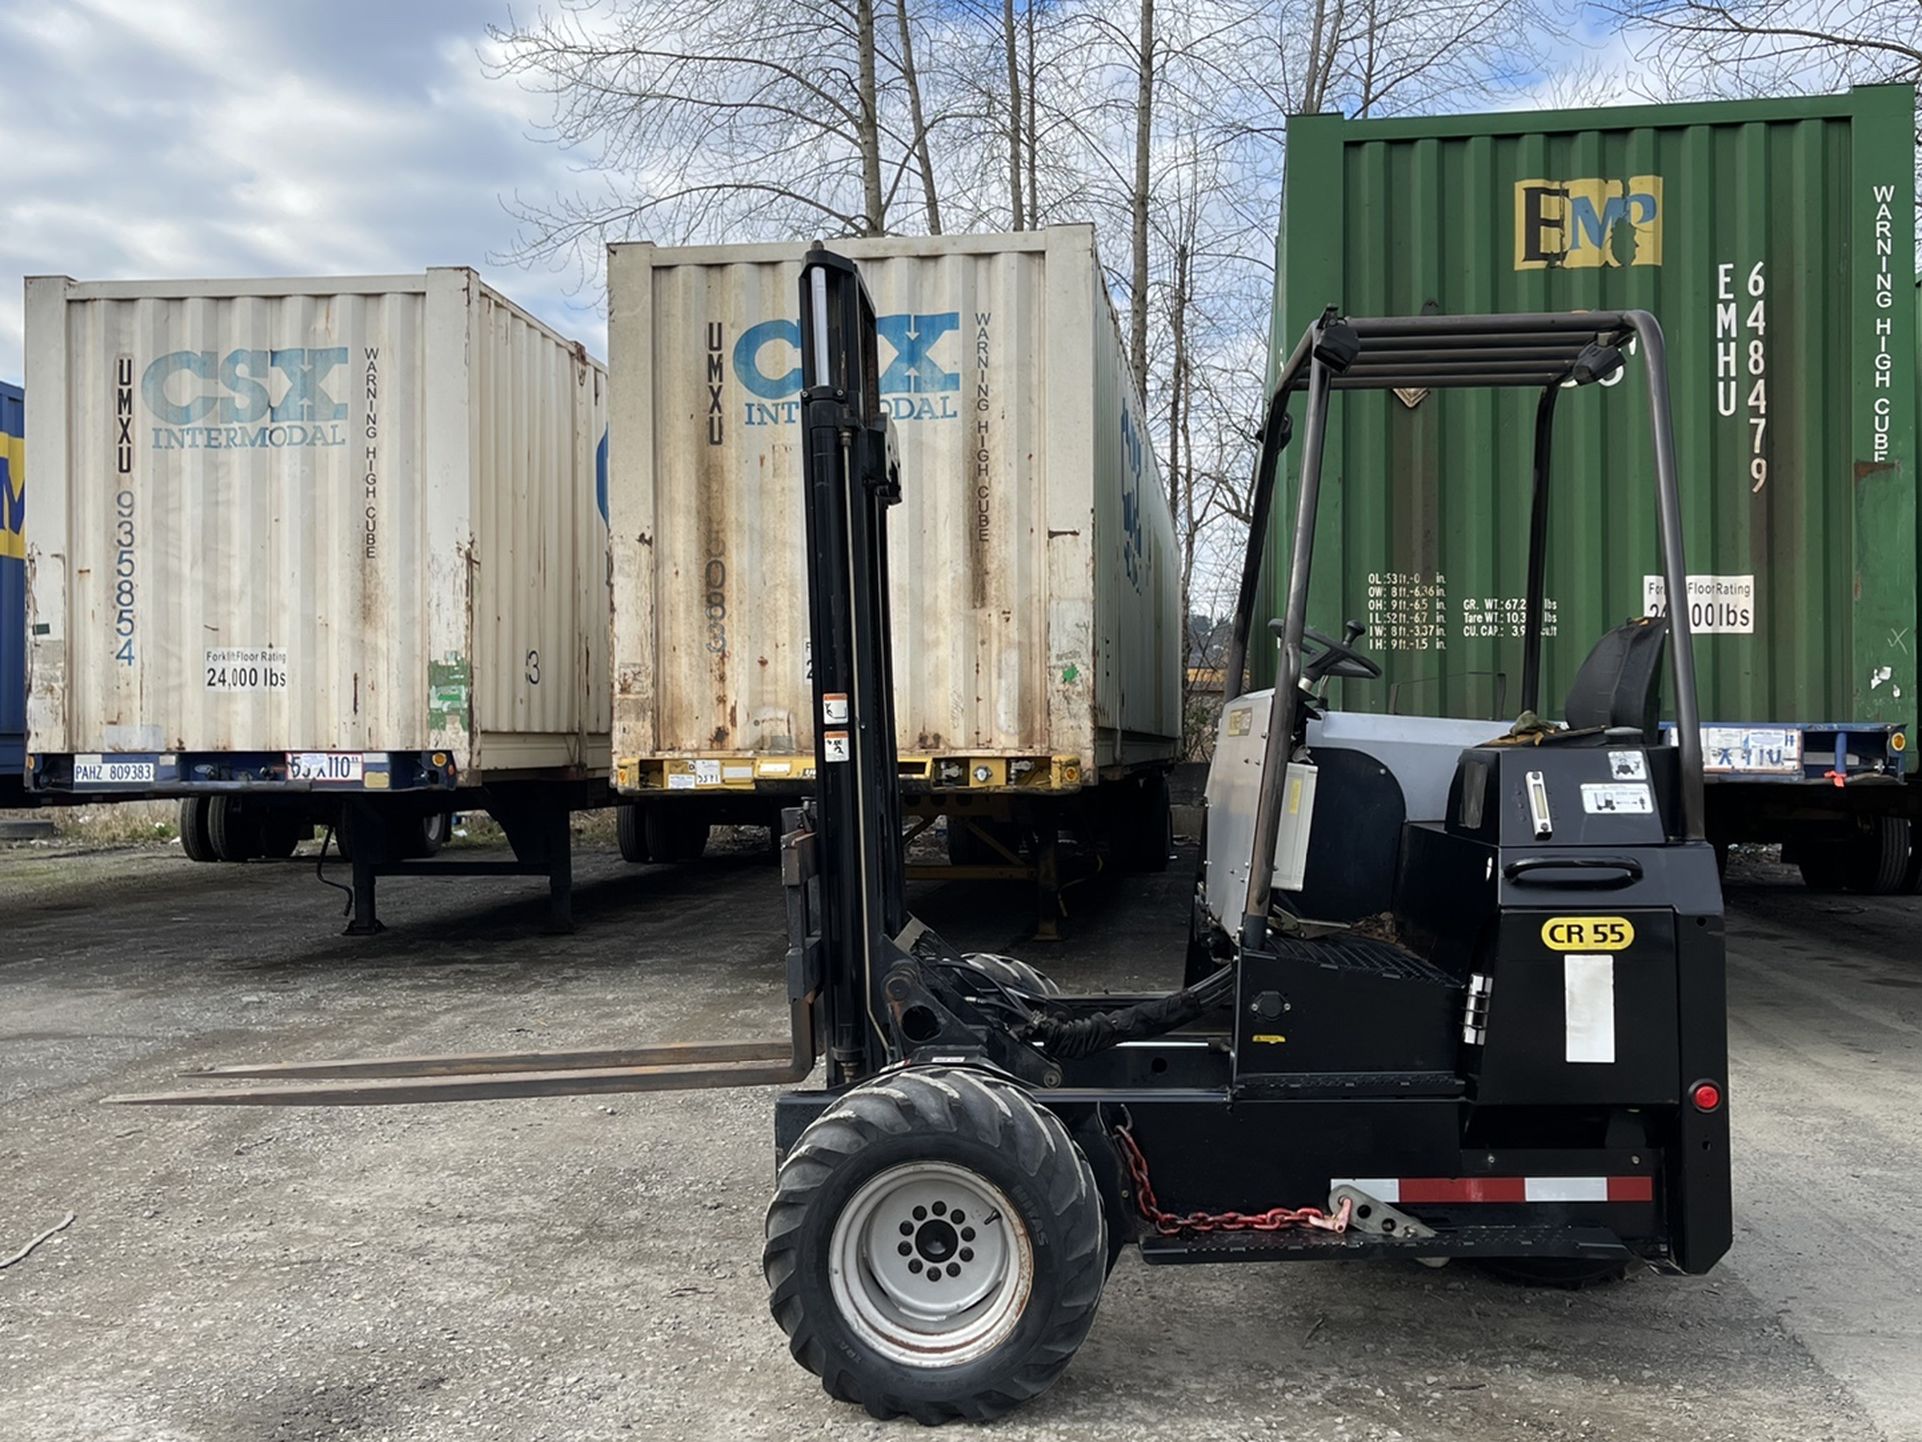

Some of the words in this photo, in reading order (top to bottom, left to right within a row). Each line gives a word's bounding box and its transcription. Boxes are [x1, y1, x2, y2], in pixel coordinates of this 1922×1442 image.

[1873, 185, 1895, 308] WARNING
[733, 312, 960, 399] CX
[975, 313, 992, 412] WARNING
[1717, 263, 1737, 417] EMHU
[1875, 317, 1892, 388] HIGH
[141, 347, 348, 427] CSX
[364, 347, 379, 439] WARNING
[708, 322, 724, 446] UMXU
[1746, 261, 1768, 493] 648479
[117, 358, 132, 473] UMXU
[151, 424, 346, 450] INTERMODAL
[365, 447, 377, 498] HIGH
[977, 421, 989, 477] HIGH
[365, 507, 377, 559] CUBE
[977, 486, 989, 542] CUBE
[115, 490, 135, 667] 935854
[1717, 582, 1751, 598] Rating
[1464, 612, 1483, 623] Tare
[1718, 602, 1751, 627] lbs
[206, 667, 259, 690] 24,000
[263, 667, 287, 687] lbs
[75, 764, 102, 780] PAHZ
[109, 763, 151, 780] 809383
[1548, 924, 1585, 943] CR
[1593, 924, 1625, 943] 55
